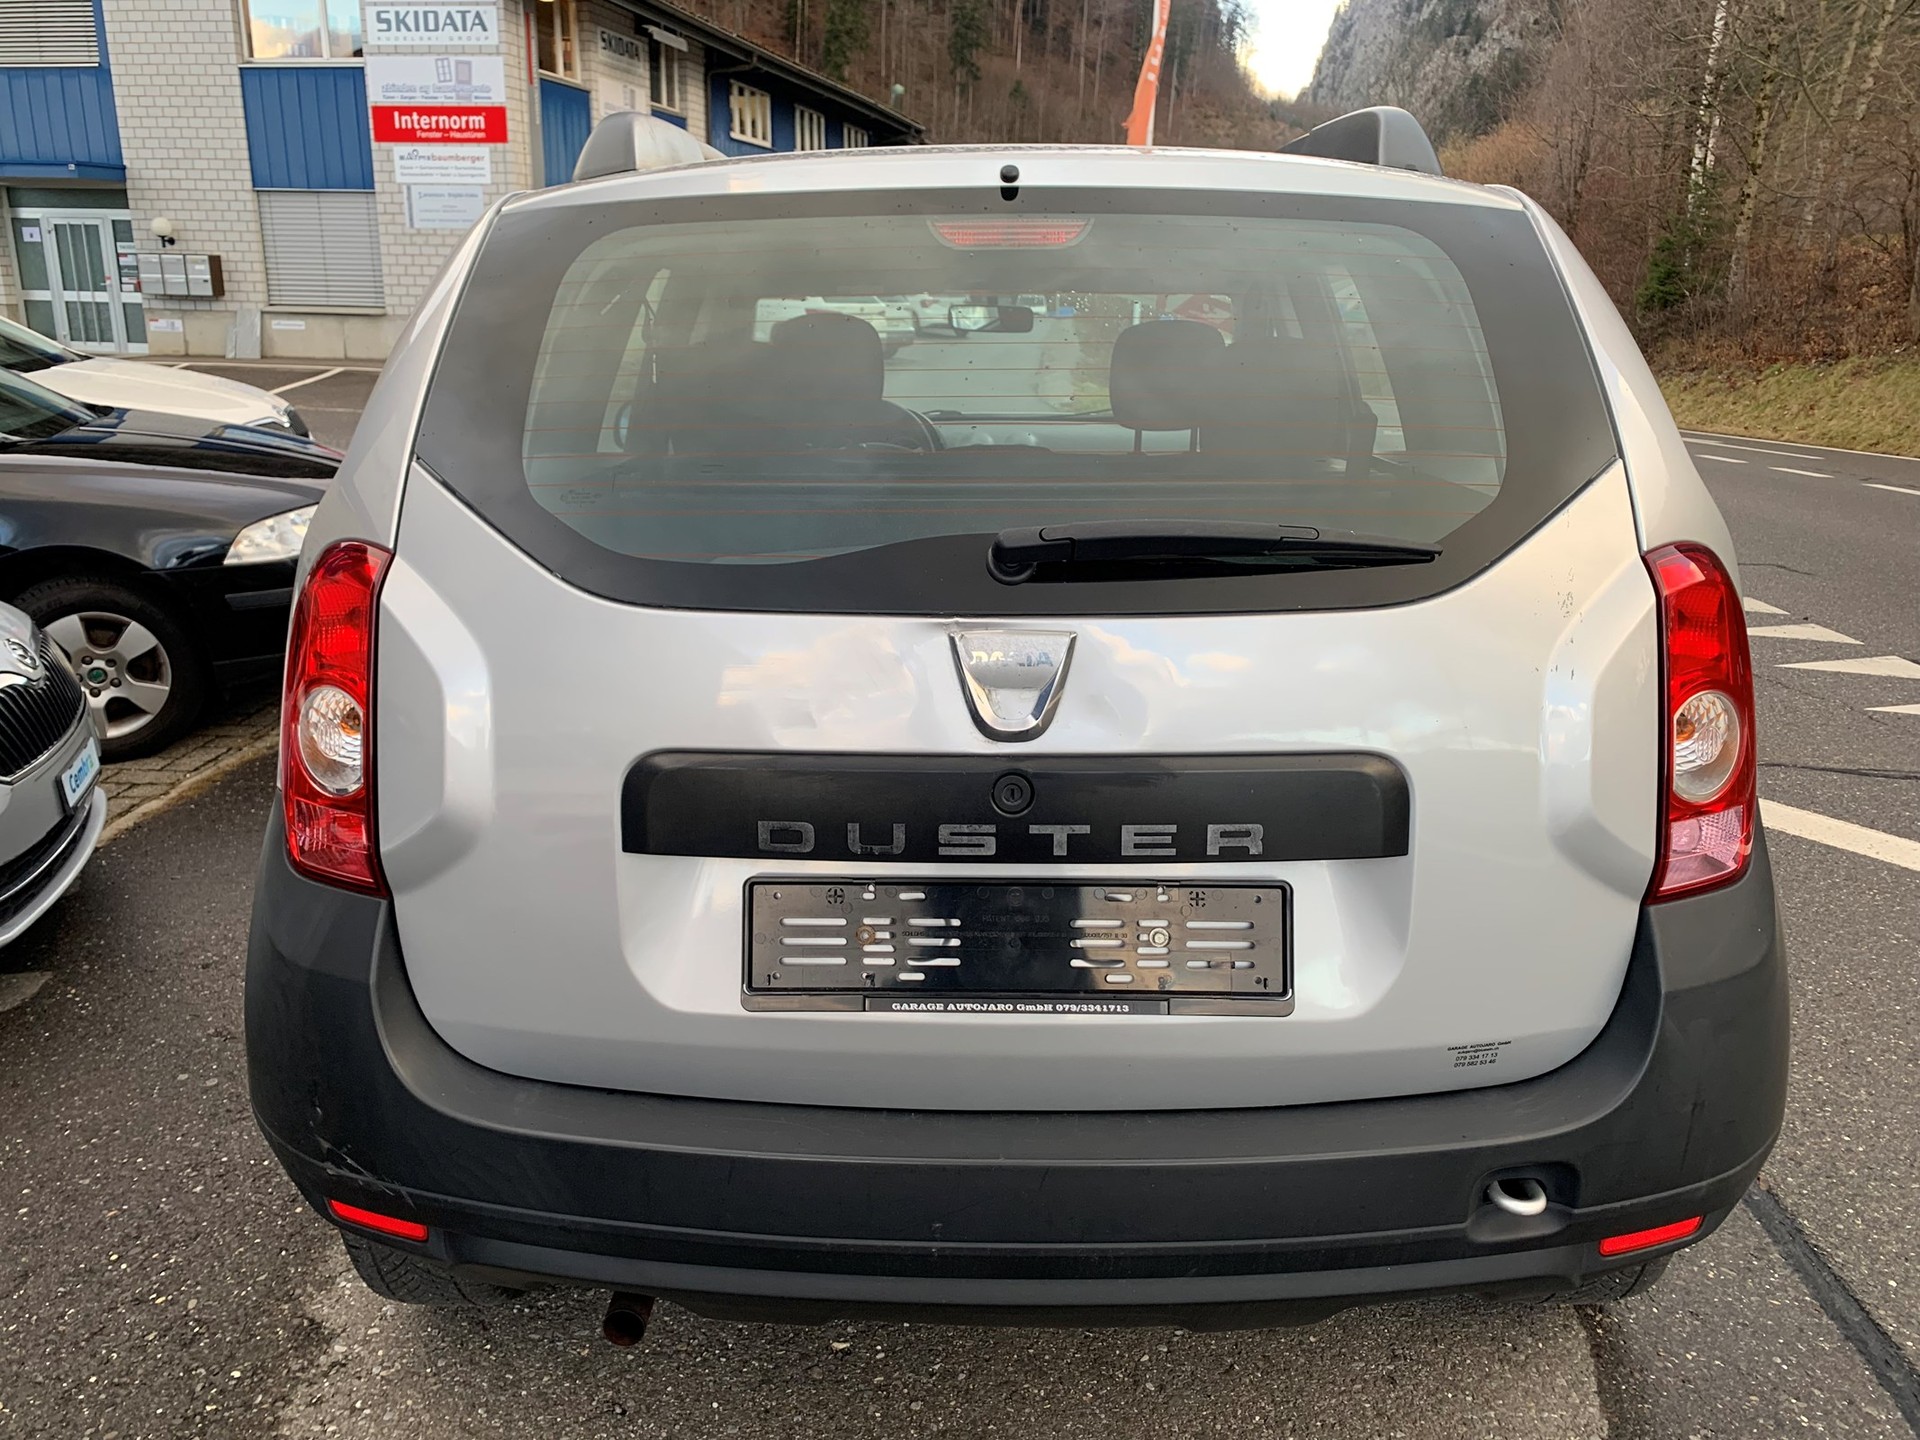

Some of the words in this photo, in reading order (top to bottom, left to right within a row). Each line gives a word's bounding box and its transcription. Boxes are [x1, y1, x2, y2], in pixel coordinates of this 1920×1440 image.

[375, 10, 488, 32] SKIDATA
[393, 111, 486, 129] Internorm
[758, 820, 1264, 856] DUSTER
[891, 1002, 944, 1011] GARAGE
[947, 1003, 1013, 1012] AUTOJARO
[1016, 1003, 1053, 1012] GmbH
[1056, 1004, 1130, 1013] 079/3341713
